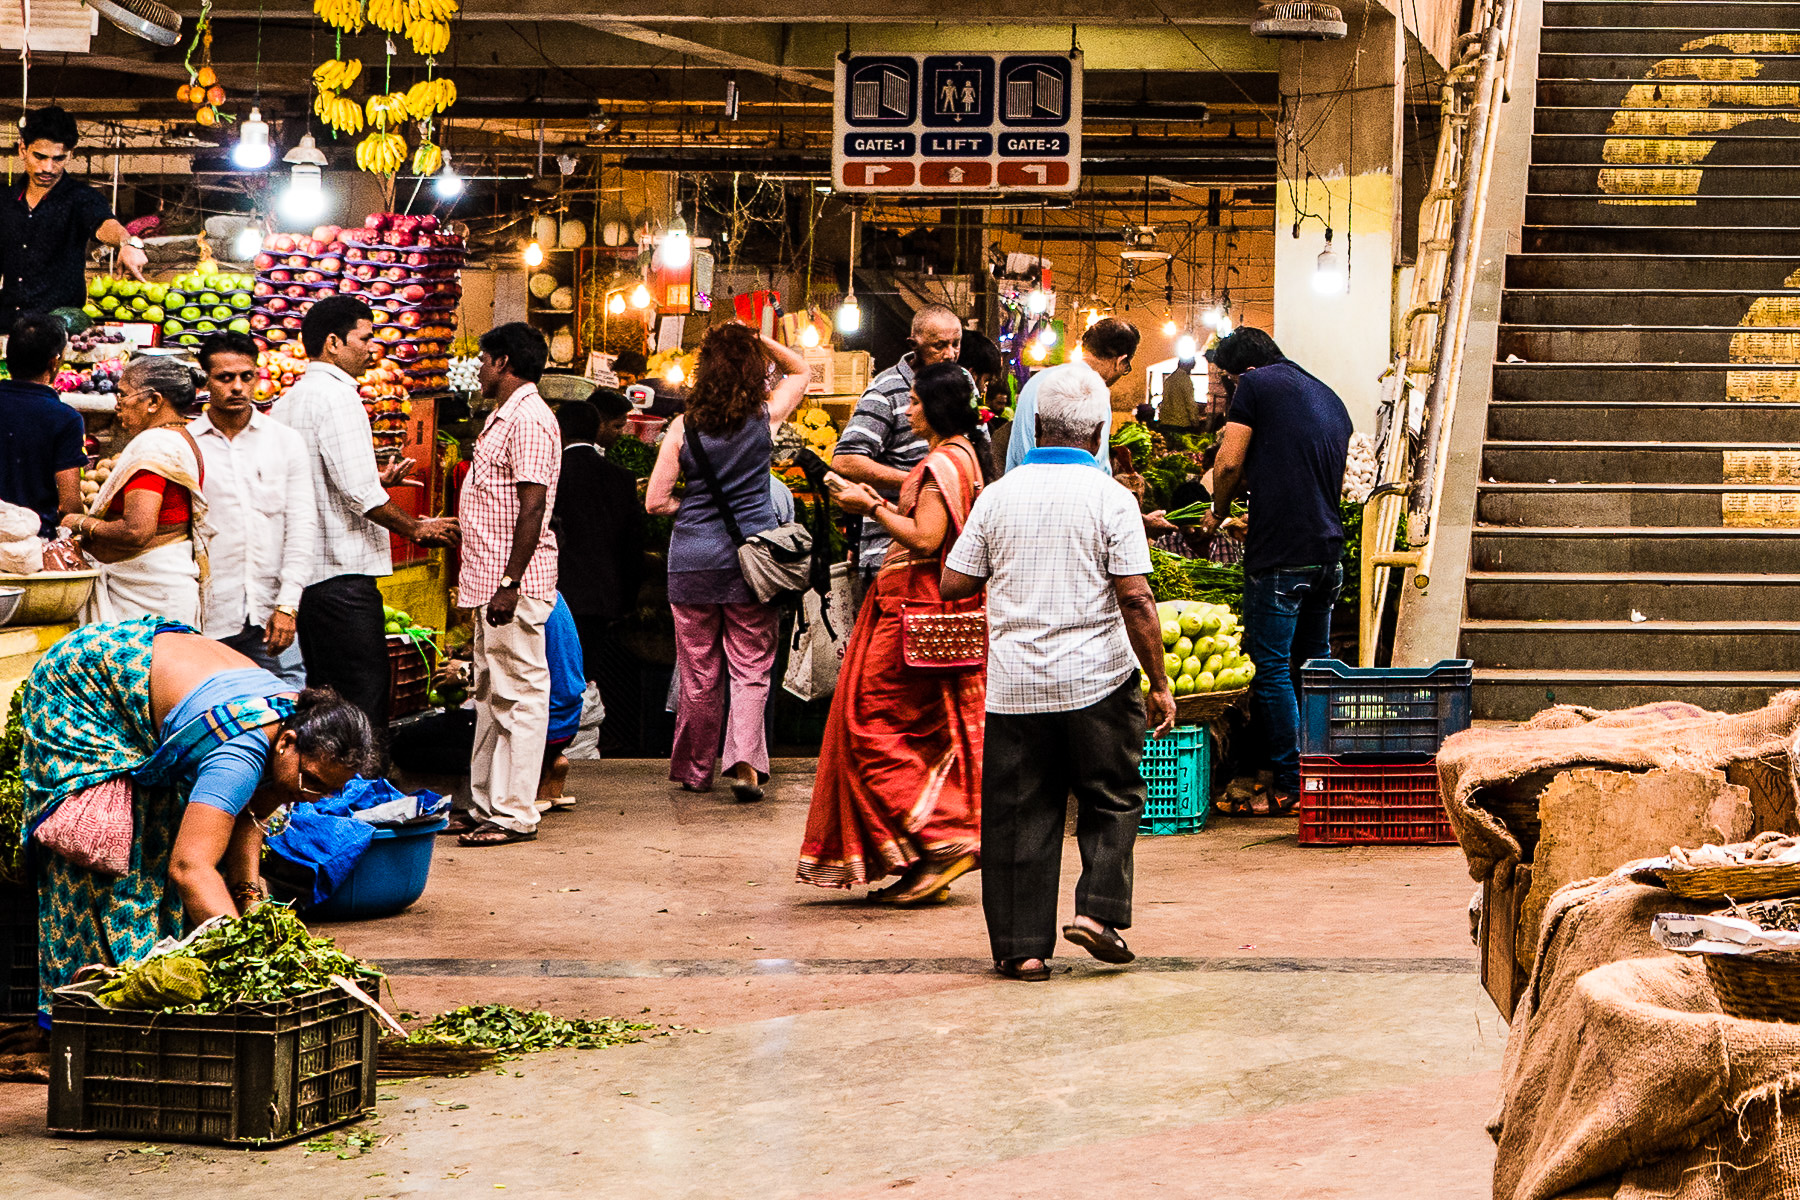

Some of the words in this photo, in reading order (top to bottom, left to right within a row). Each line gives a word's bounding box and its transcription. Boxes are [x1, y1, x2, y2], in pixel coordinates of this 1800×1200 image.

[855, 140, 905, 151] GATE-1
[932, 140, 982, 150] LIFT
[1008, 139, 1060, 151] GATE-2
